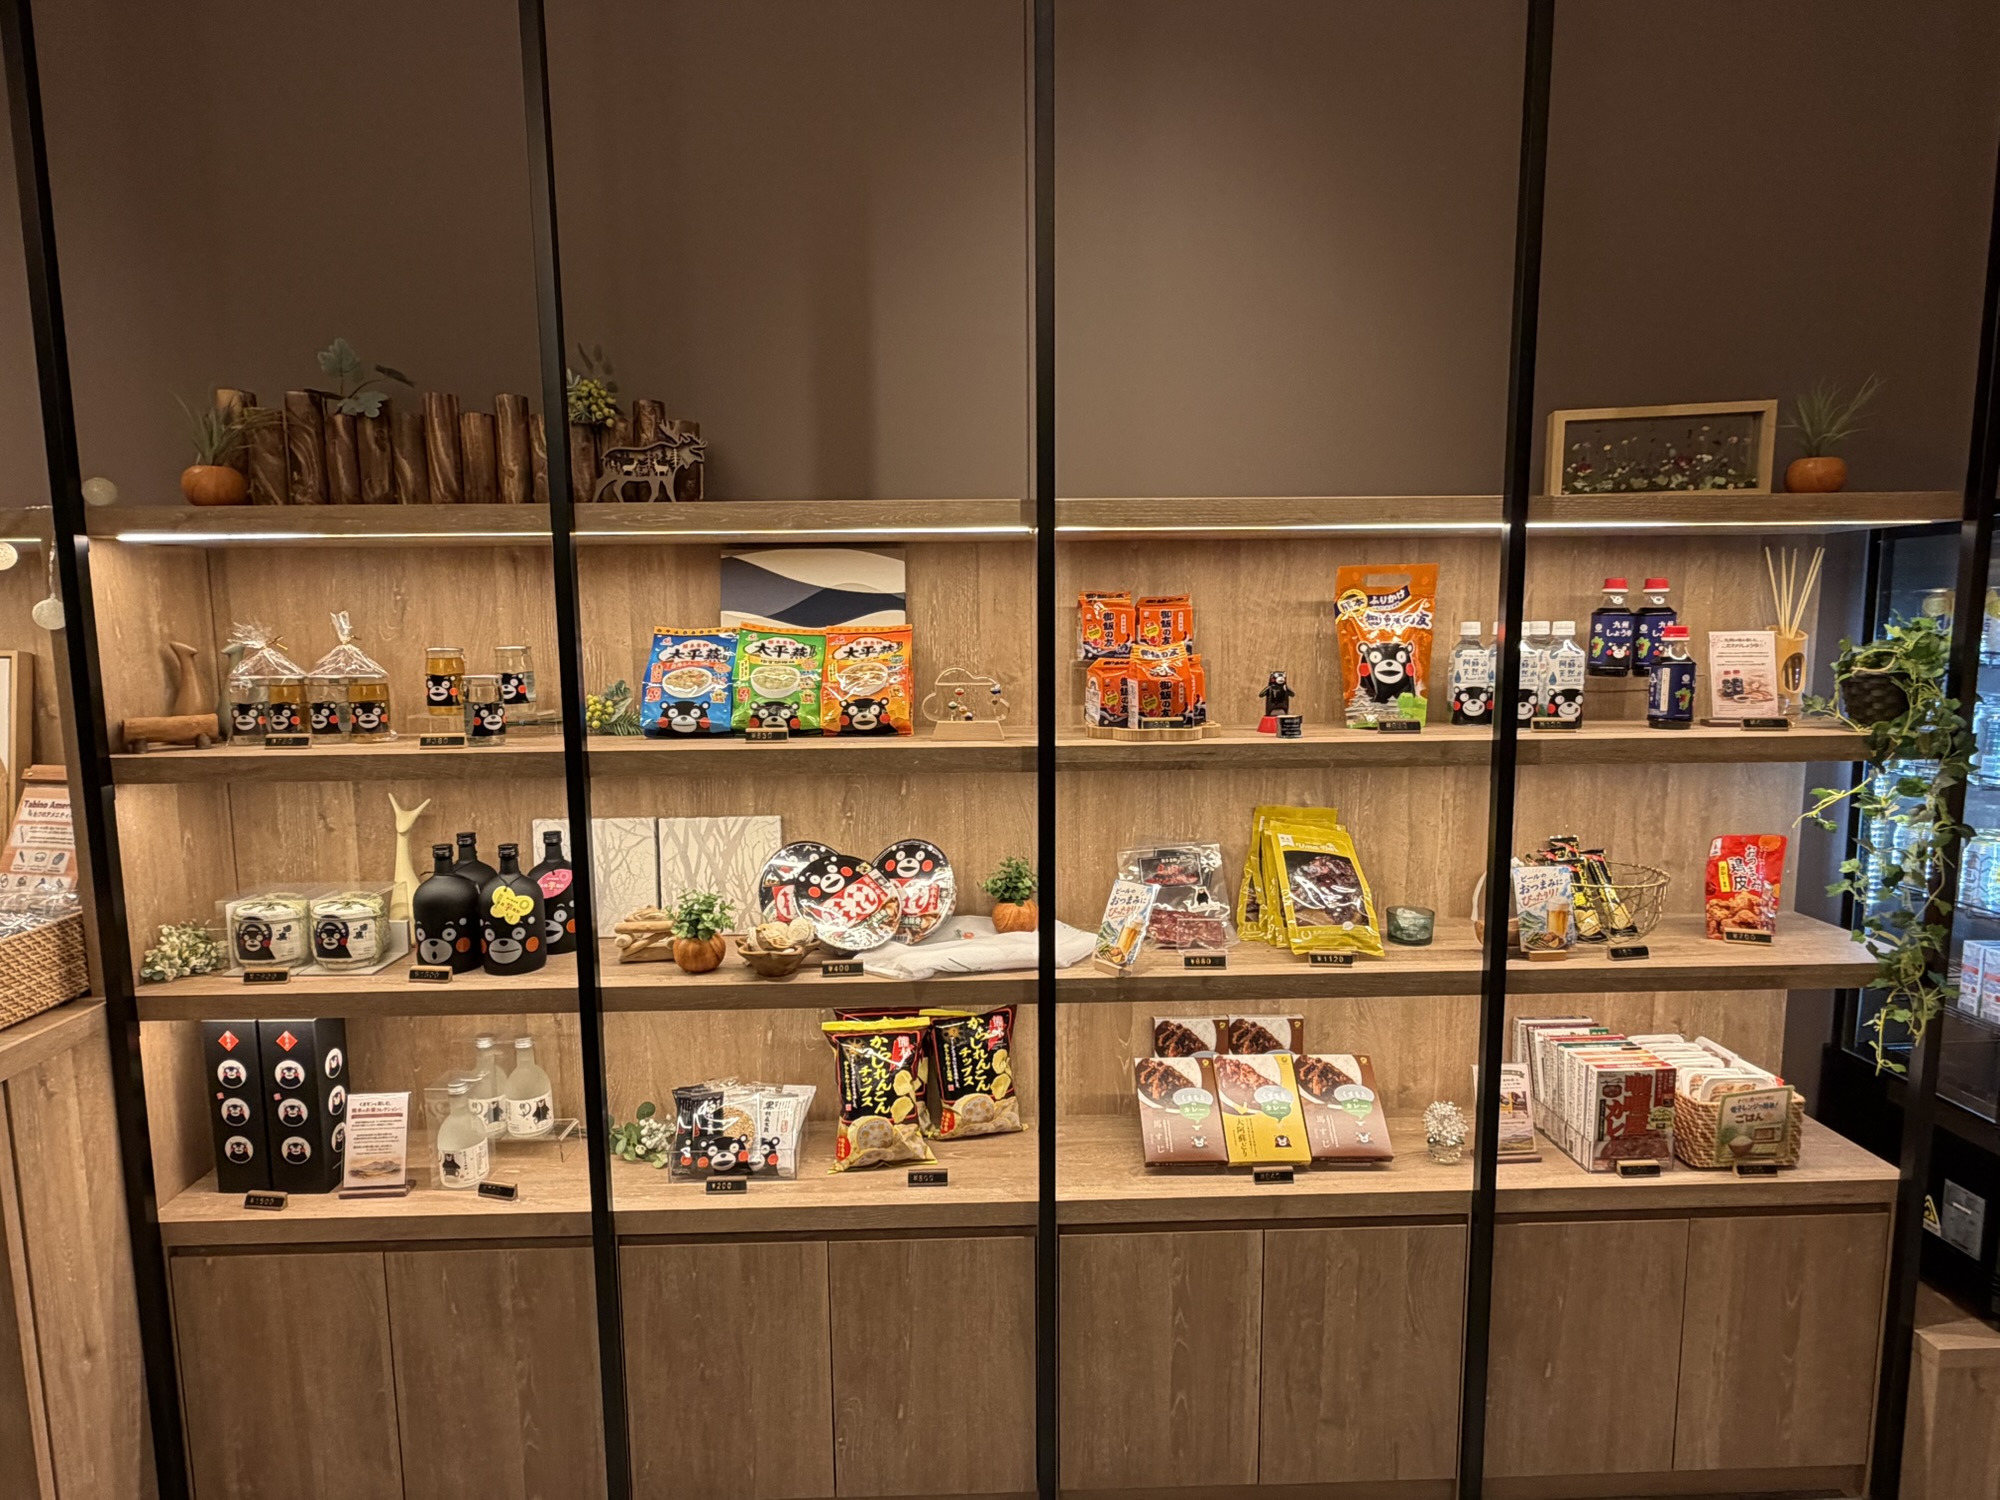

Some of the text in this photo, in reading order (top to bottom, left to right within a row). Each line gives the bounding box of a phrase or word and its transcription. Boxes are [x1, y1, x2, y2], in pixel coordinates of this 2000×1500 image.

[1369, 590, 1405, 605] ふりかけ
[1103, 612, 1114, 647] 御飯の友
[1161, 610, 1172, 645] 御飯の友
[1612, 620, 1630, 629] 九州
[752, 642, 809, 659] 太平燕
[1521, 660, 1538, 668] 蘇山
[1521, 669, 1537, 677] 然水
[1159, 680, 1172, 717] 御飯の友
[1519, 879, 1563, 895] おつまみに
[1110, 895, 1147, 906] おつまみに
[967, 1016, 991, 1092] からしれんこん
[870, 1035, 892, 1114] からしれんこん
[959, 1047, 974, 1086] チップス
[858, 1065, 873, 1107] チップス
[1735, 1112, 1764, 1123] ごはん
[711, 1182, 732, 1190] ¥200
